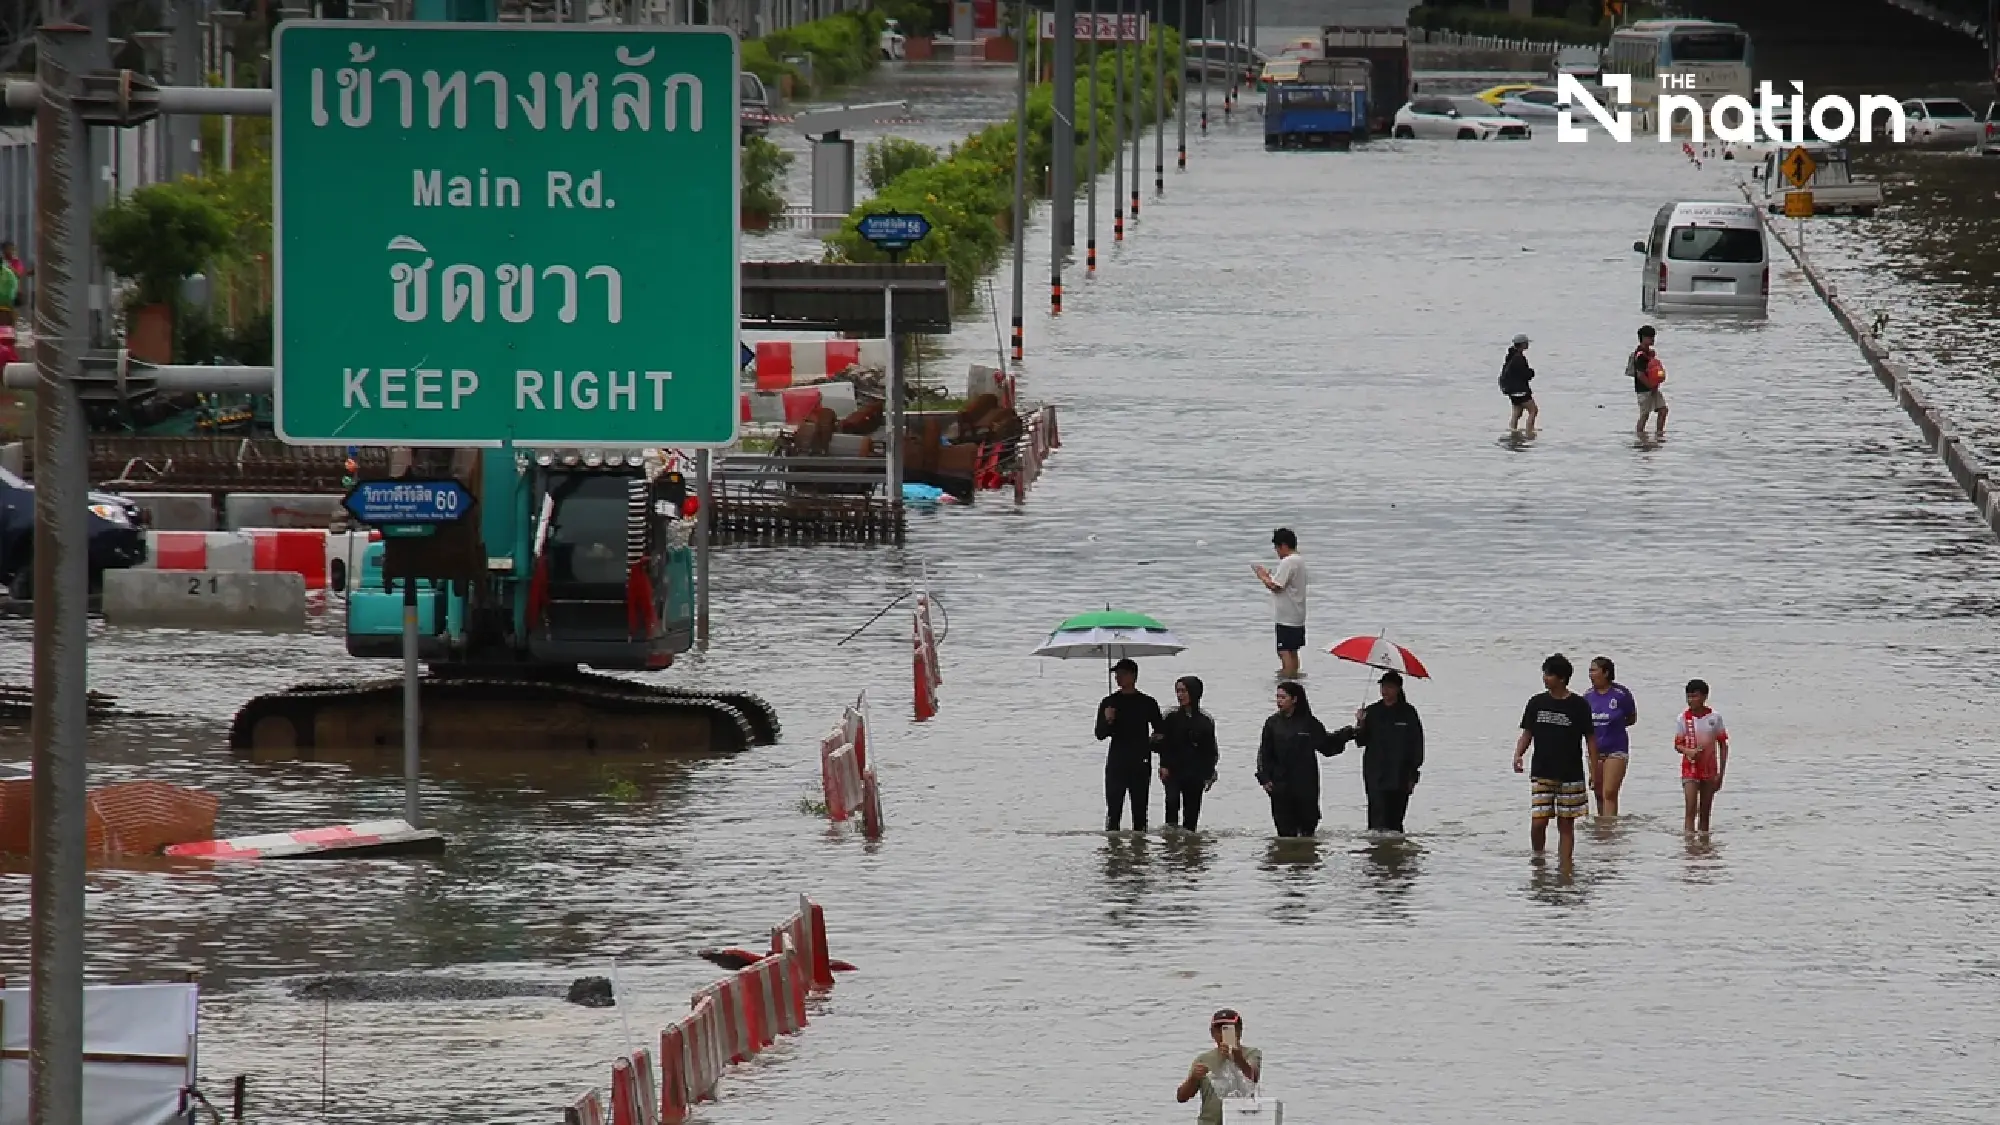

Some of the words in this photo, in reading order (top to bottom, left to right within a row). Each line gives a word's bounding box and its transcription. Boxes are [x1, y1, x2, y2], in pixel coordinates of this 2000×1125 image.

[311, 42, 703, 132] เข้าทางหลัก
[413, 167, 521, 207] Main
[547, 170, 616, 209] Rd.
[387, 234, 623, 324] ชิดขวา
[343, 367, 479, 410] KEEP
[516, 370, 673, 411] RIGHT
[436, 490, 458, 510] 60
[188, 576, 217, 595] 21
